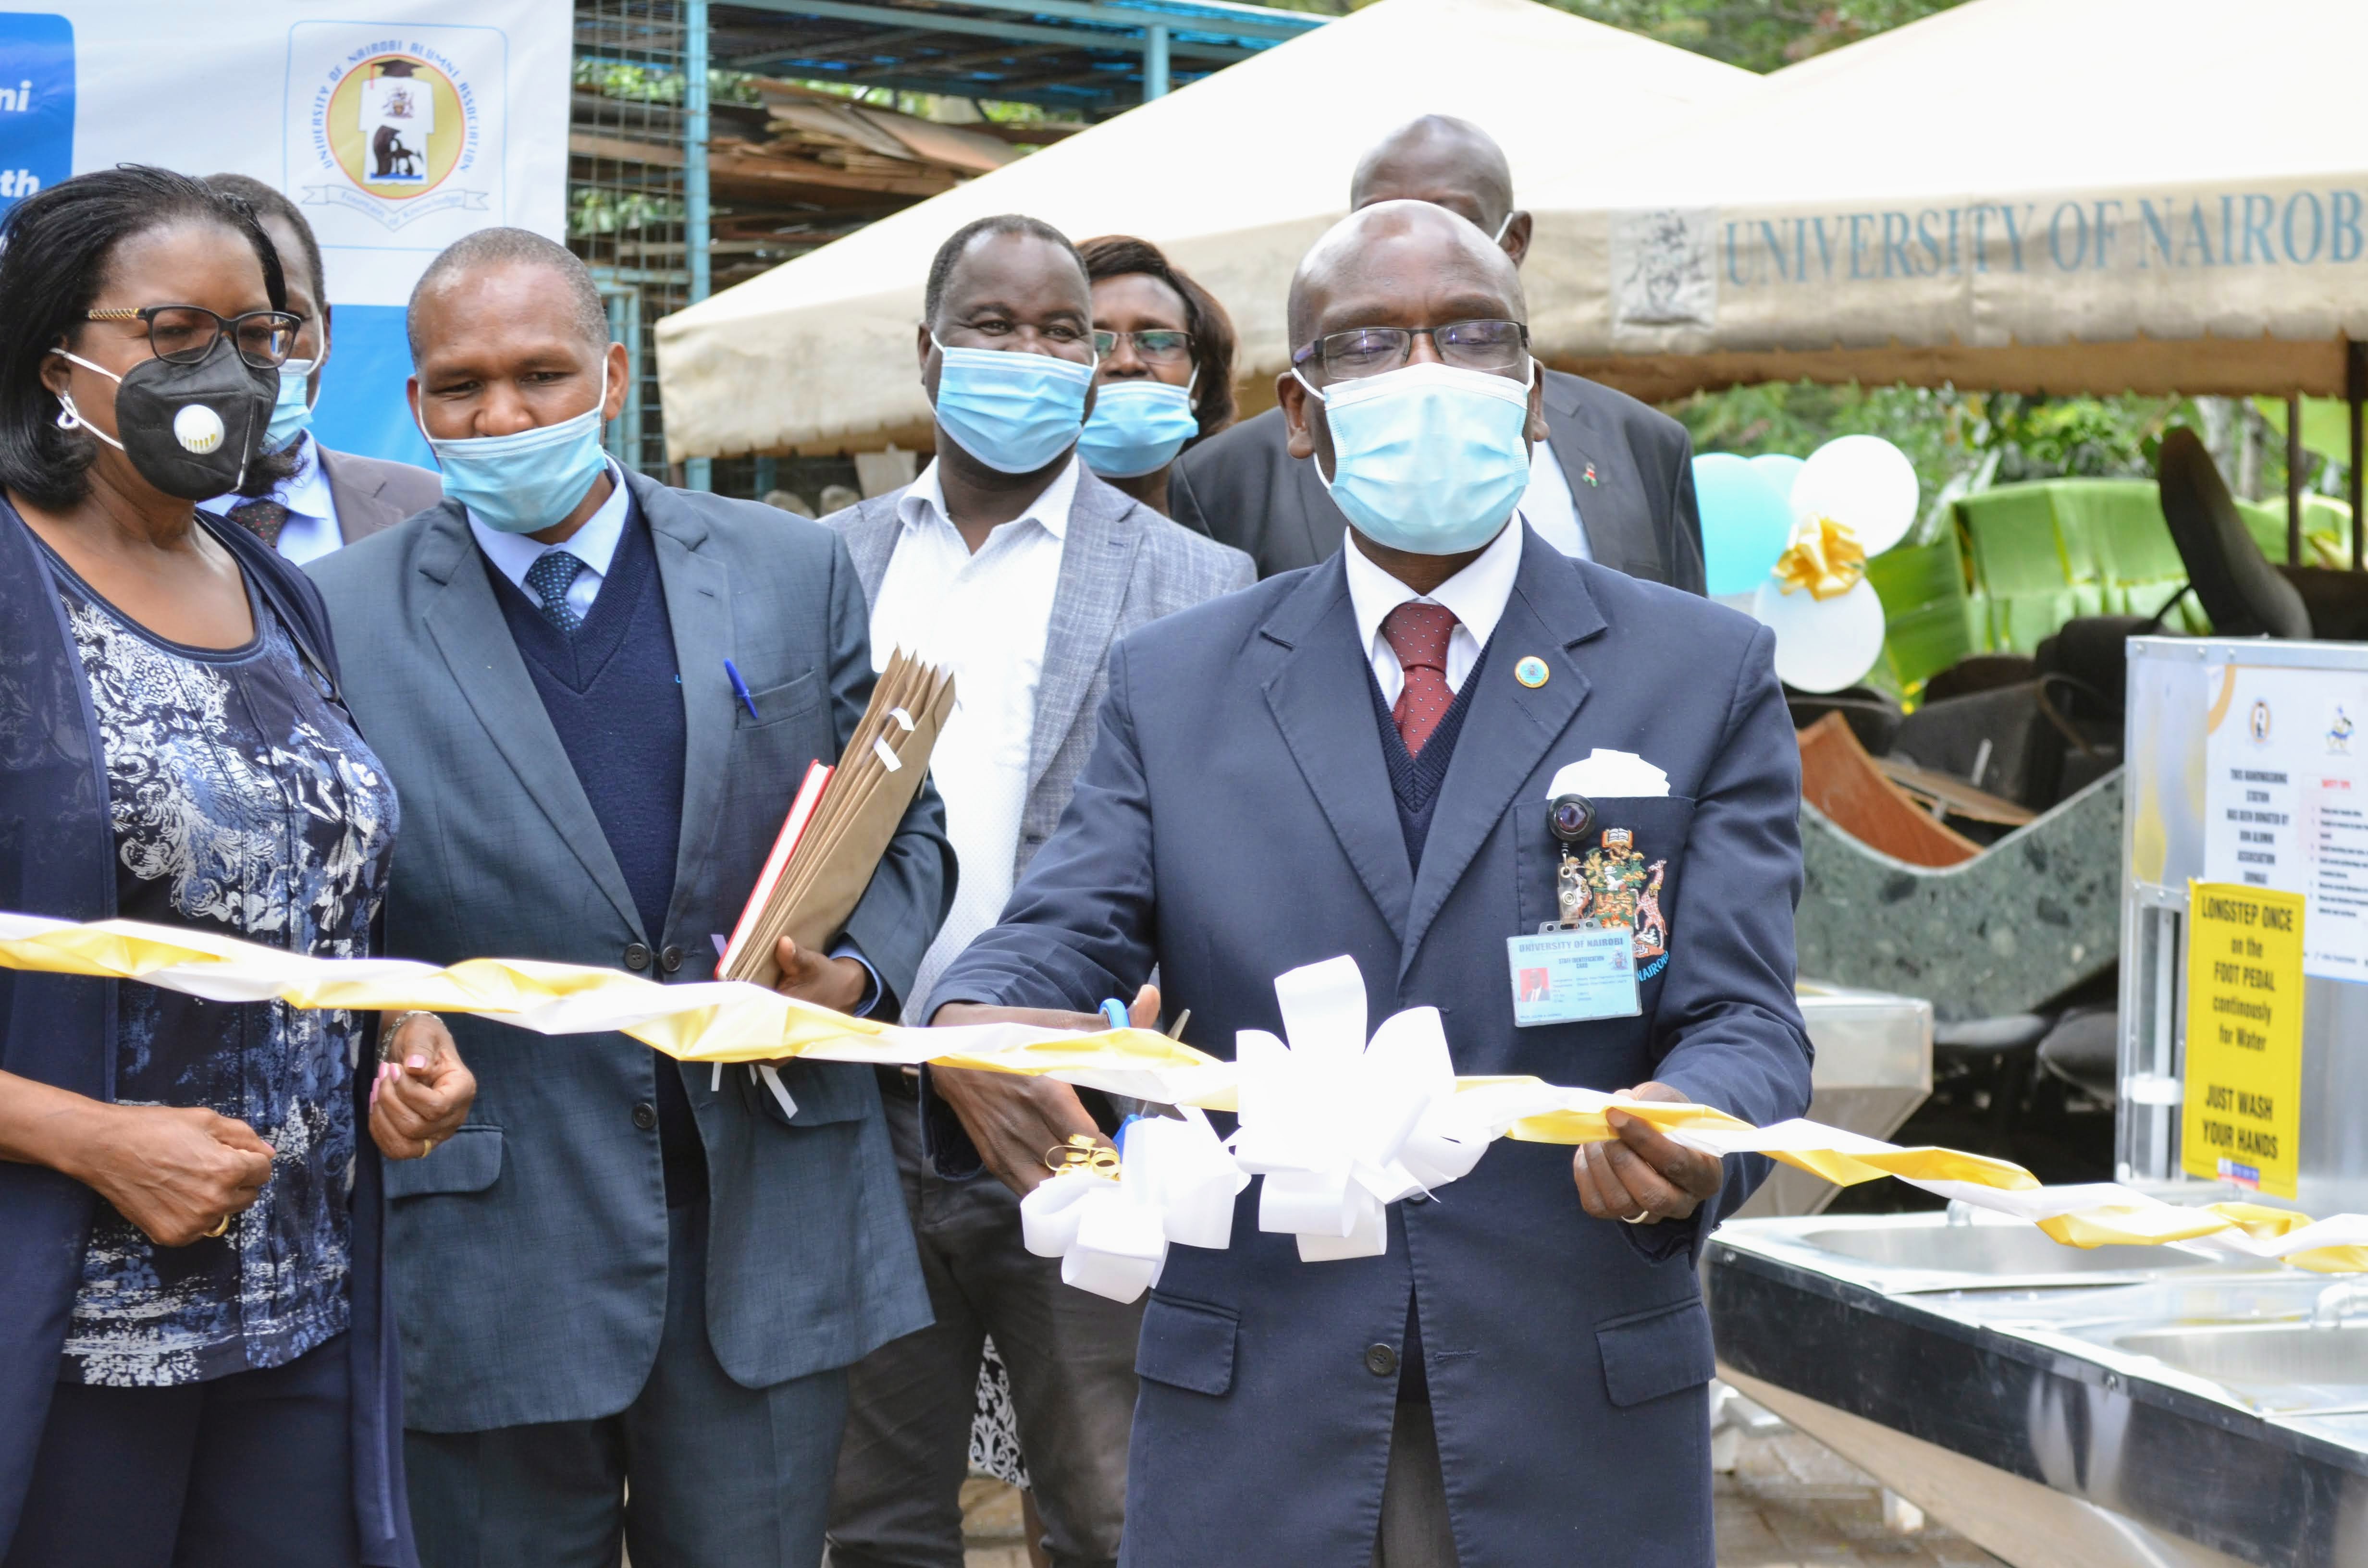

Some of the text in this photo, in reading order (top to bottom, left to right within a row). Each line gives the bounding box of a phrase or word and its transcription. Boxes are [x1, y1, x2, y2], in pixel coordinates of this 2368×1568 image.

[1724, 204, 2035, 287] UNIVERSITY
[2048, 200, 2123, 272] OF
[2201, 896, 2293, 932] LONGSTEP ONCE
[1519, 937, 1624, 952] UNIVERSITY OF NAIROBI
[2232, 938, 2263, 958] on the
[2214, 960, 2276, 992] FOOT PEDAL
[2219, 1023, 2267, 1052] for Water
[2205, 1083, 2273, 1122] JUST WASH
[2202, 1118, 2279, 1160] YOUR HANDS
